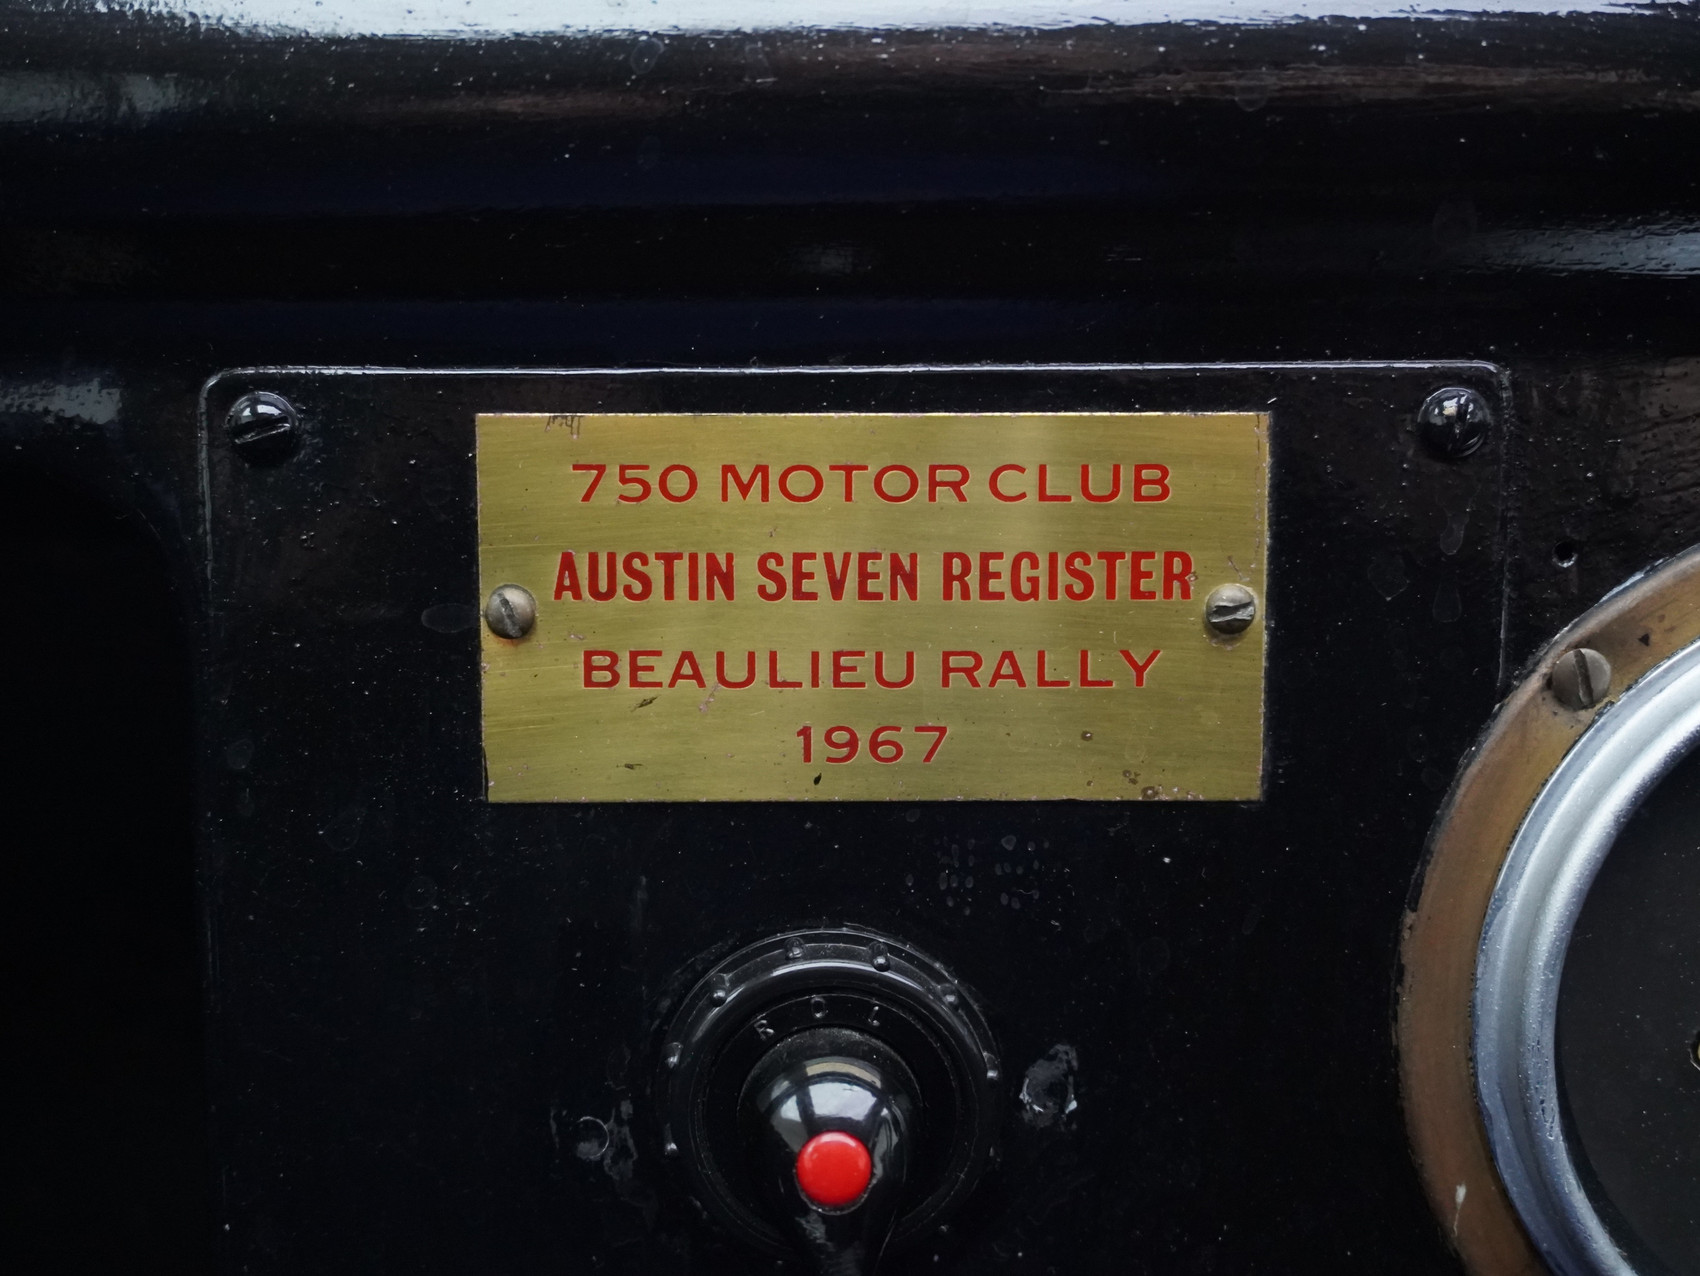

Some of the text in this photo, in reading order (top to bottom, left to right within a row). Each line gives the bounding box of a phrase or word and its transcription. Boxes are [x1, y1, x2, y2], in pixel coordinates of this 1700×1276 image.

[572, 463, 1172, 503] 750 MOTOR CLUB
[553, 550, 1194, 602] AUSTIN SEVEN REGISTER
[583, 649, 1161, 689] BEAULIEU RALLY
[796, 725, 948, 763] 1967
